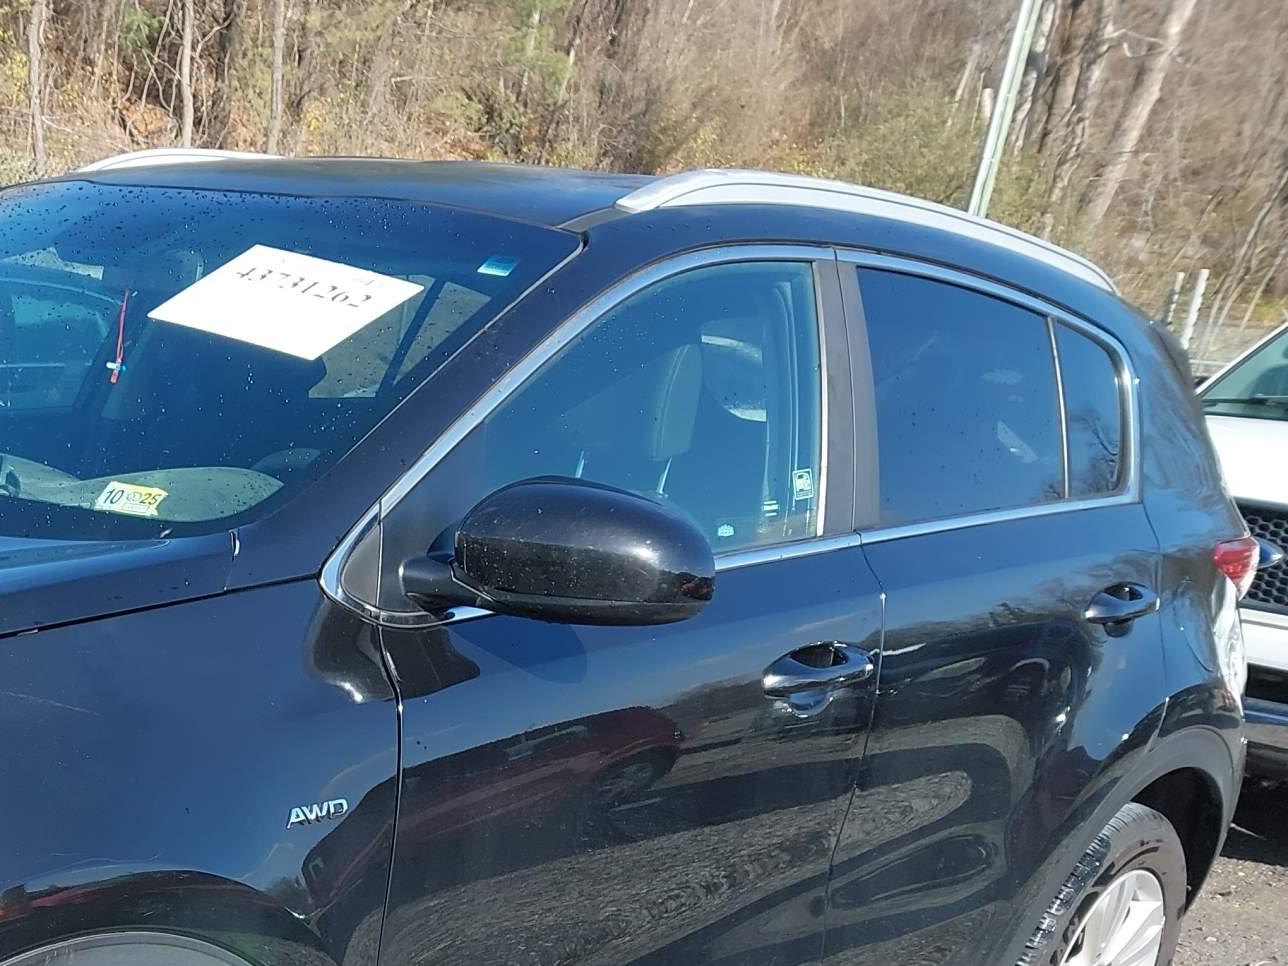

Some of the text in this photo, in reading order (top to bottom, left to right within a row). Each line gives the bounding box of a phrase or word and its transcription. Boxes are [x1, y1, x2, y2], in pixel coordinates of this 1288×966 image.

[236, 267, 373, 308] 43731262
[103, 488, 162, 506] 10 25
[286, 798, 349, 830] AWD
